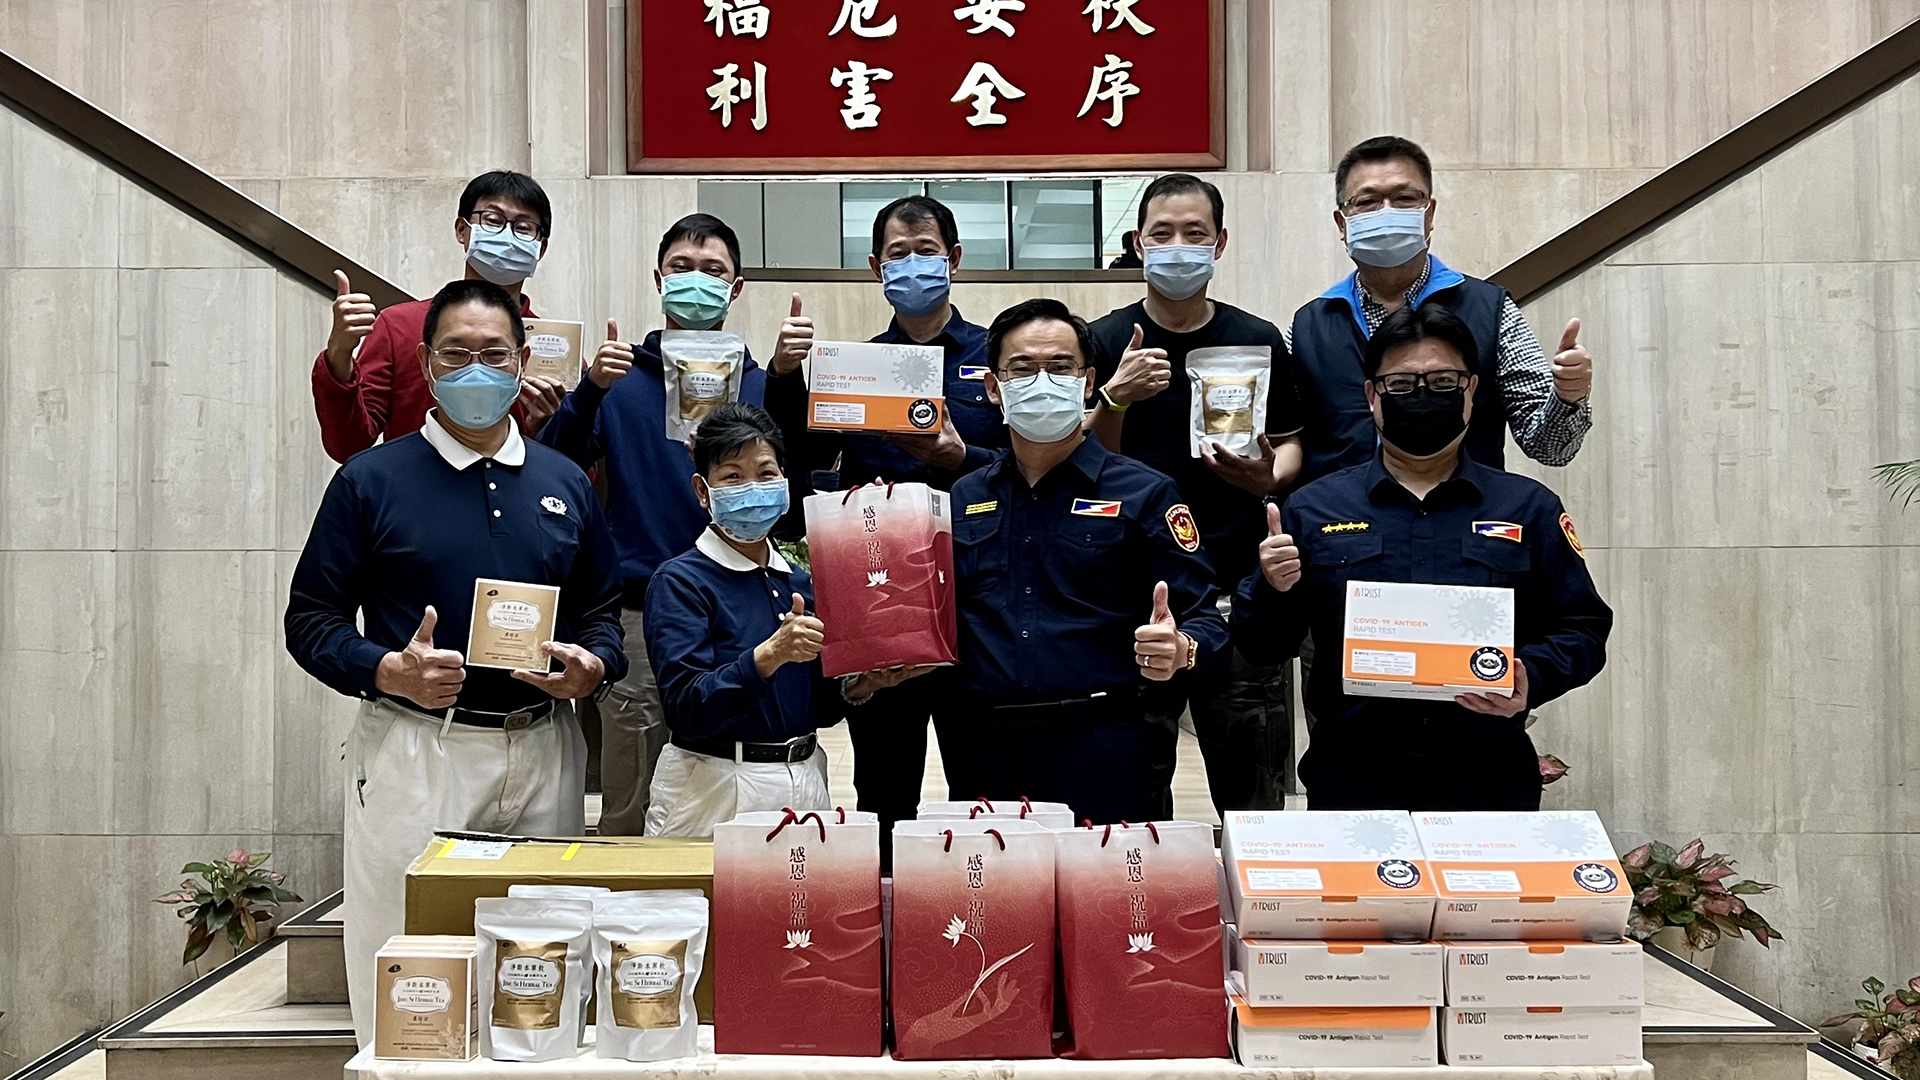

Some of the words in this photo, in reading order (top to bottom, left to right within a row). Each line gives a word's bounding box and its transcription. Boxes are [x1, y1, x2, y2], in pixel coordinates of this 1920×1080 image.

[1354, 617, 1390, 625] COVID-19
[1394, 619, 1428, 628] ANTIGEN
[1353, 626, 1376, 634] RAPID
